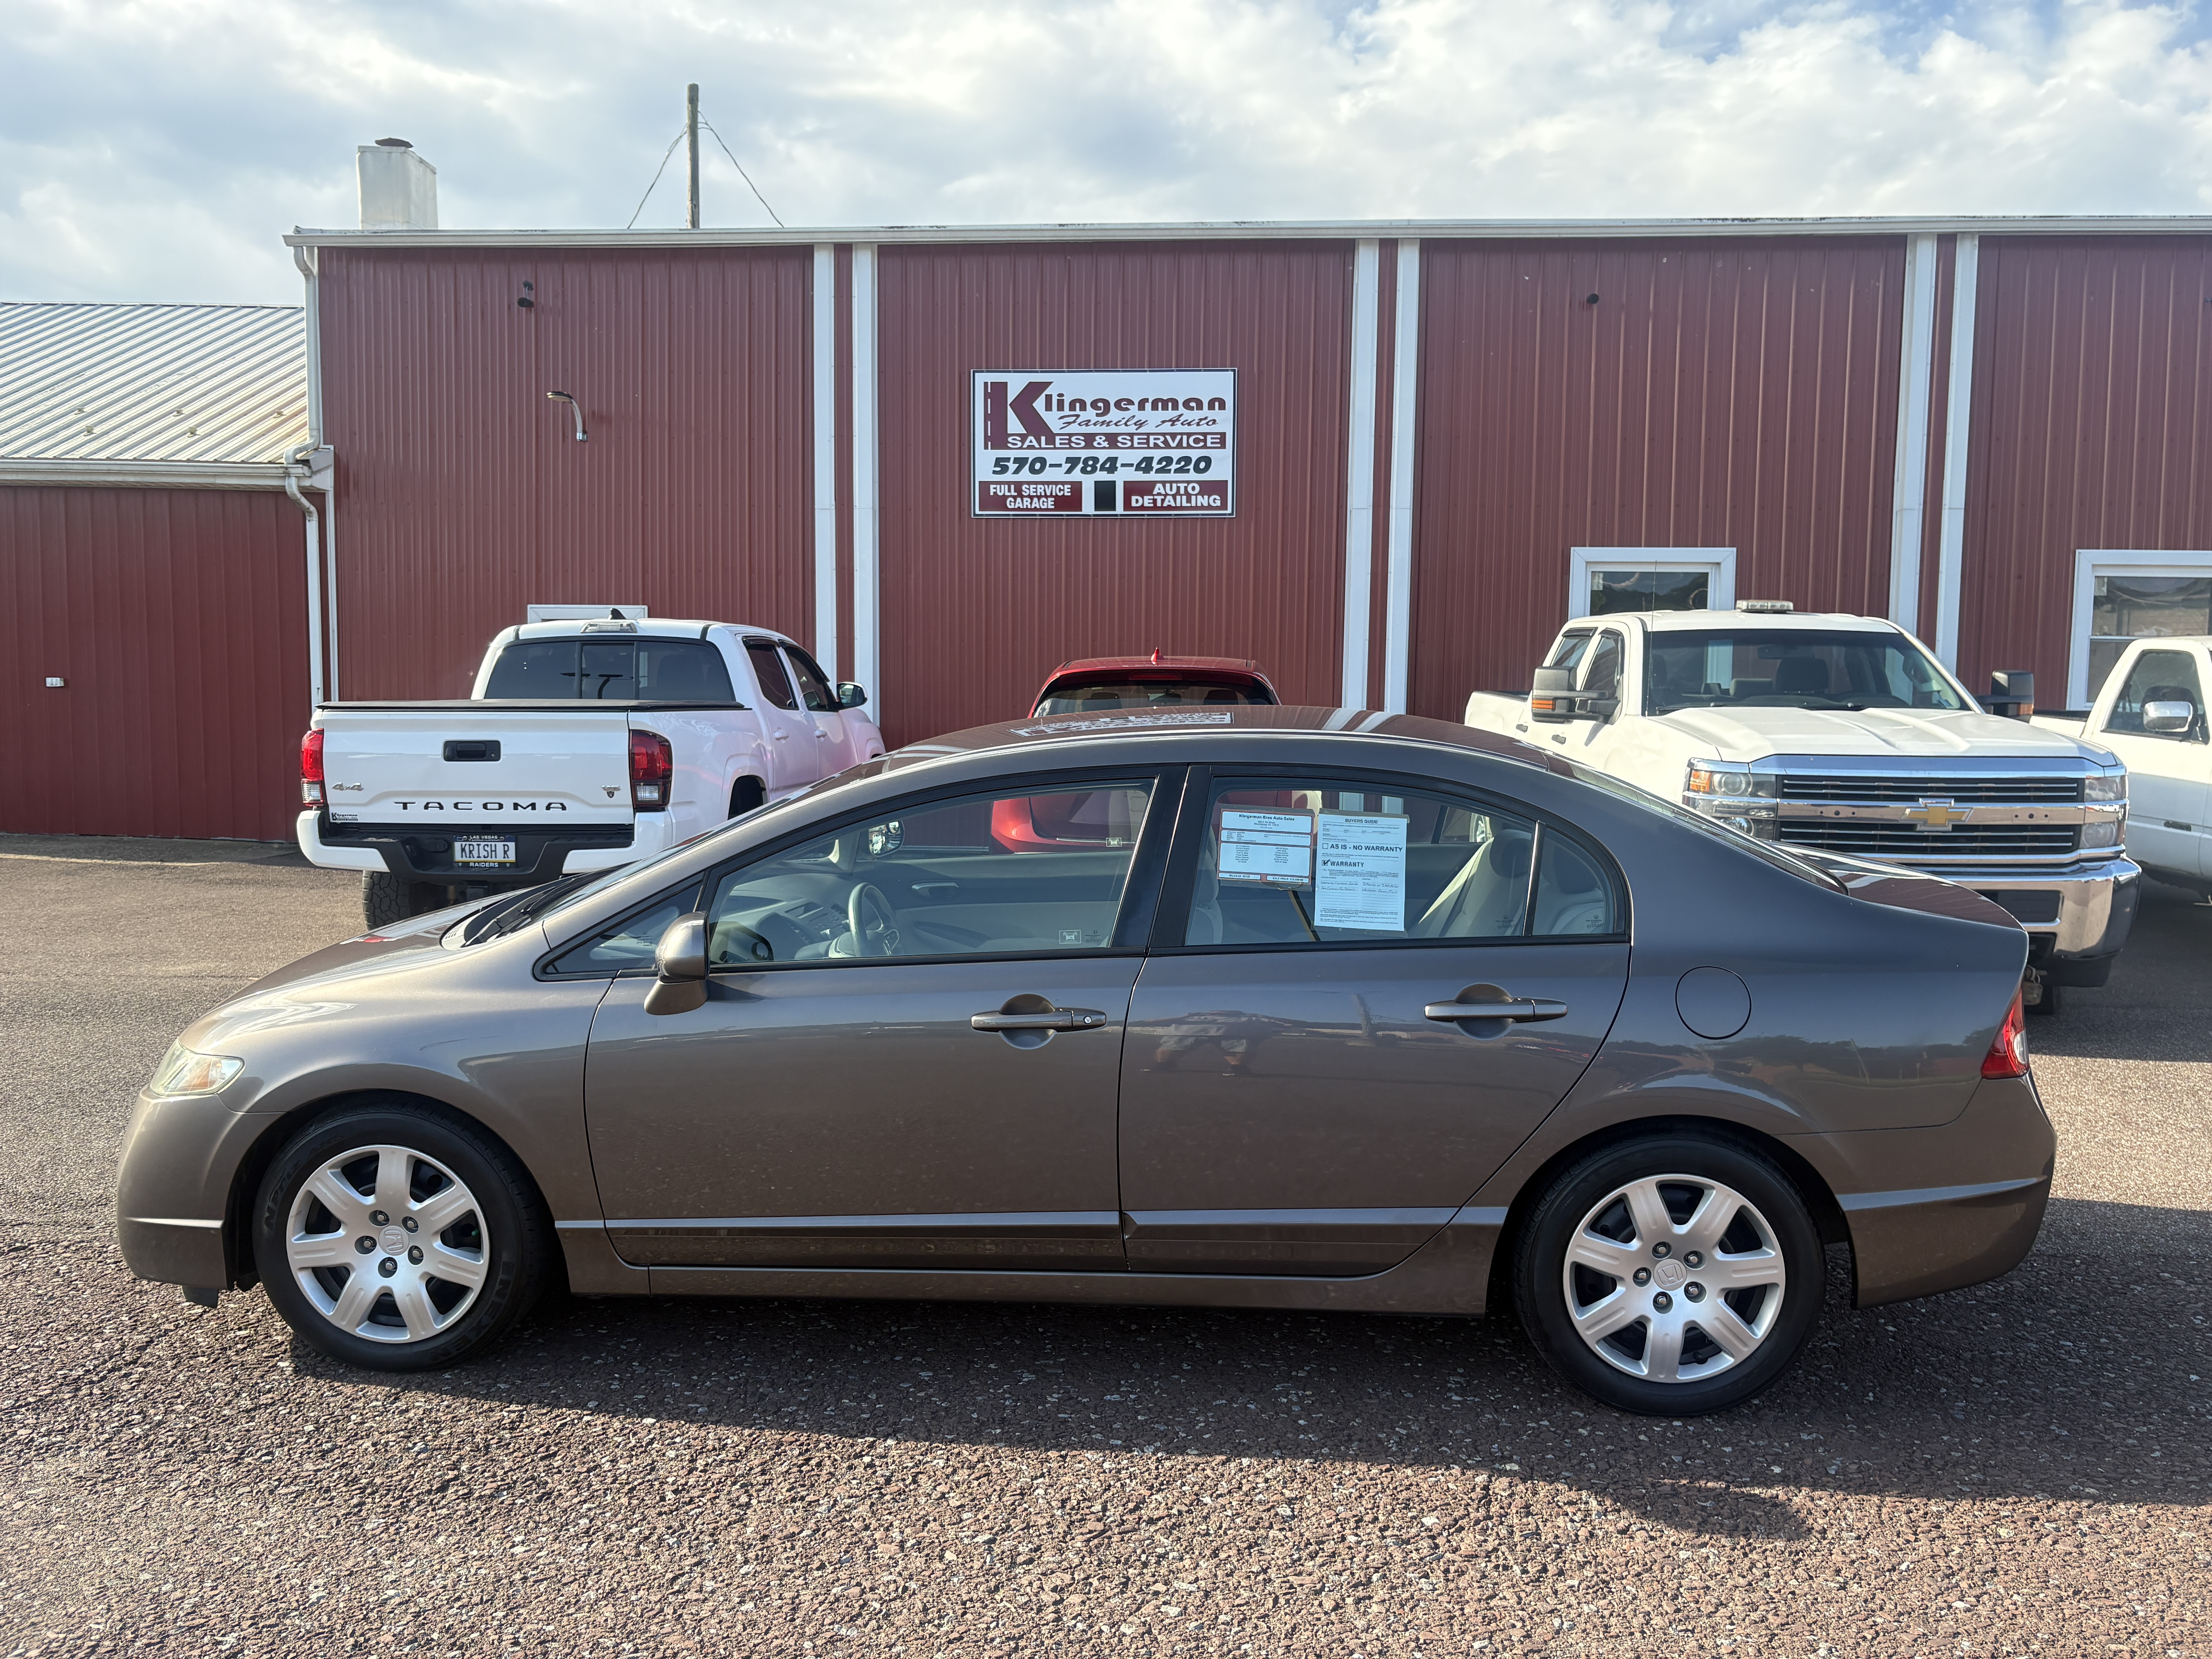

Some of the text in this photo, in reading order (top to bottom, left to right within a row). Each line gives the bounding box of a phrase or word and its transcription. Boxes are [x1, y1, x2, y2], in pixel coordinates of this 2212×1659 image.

[984, 381, 1226, 450] Klingerman
[1057, 413, 1219, 431] Family Auto
[1007, 434, 1221, 448] SALES & SERVICE
[992, 456, 1212, 475] 570-784-4220
[990, 485, 1071, 496] FULL SERVICE
[1152, 484, 1200, 495] AUTO
[1006, 498, 1054, 509] GARAGE
[1131, 495, 1221, 507] DETAILING
[394, 802, 567, 811] TACOMA
[461, 843, 509, 859] KRISH R
